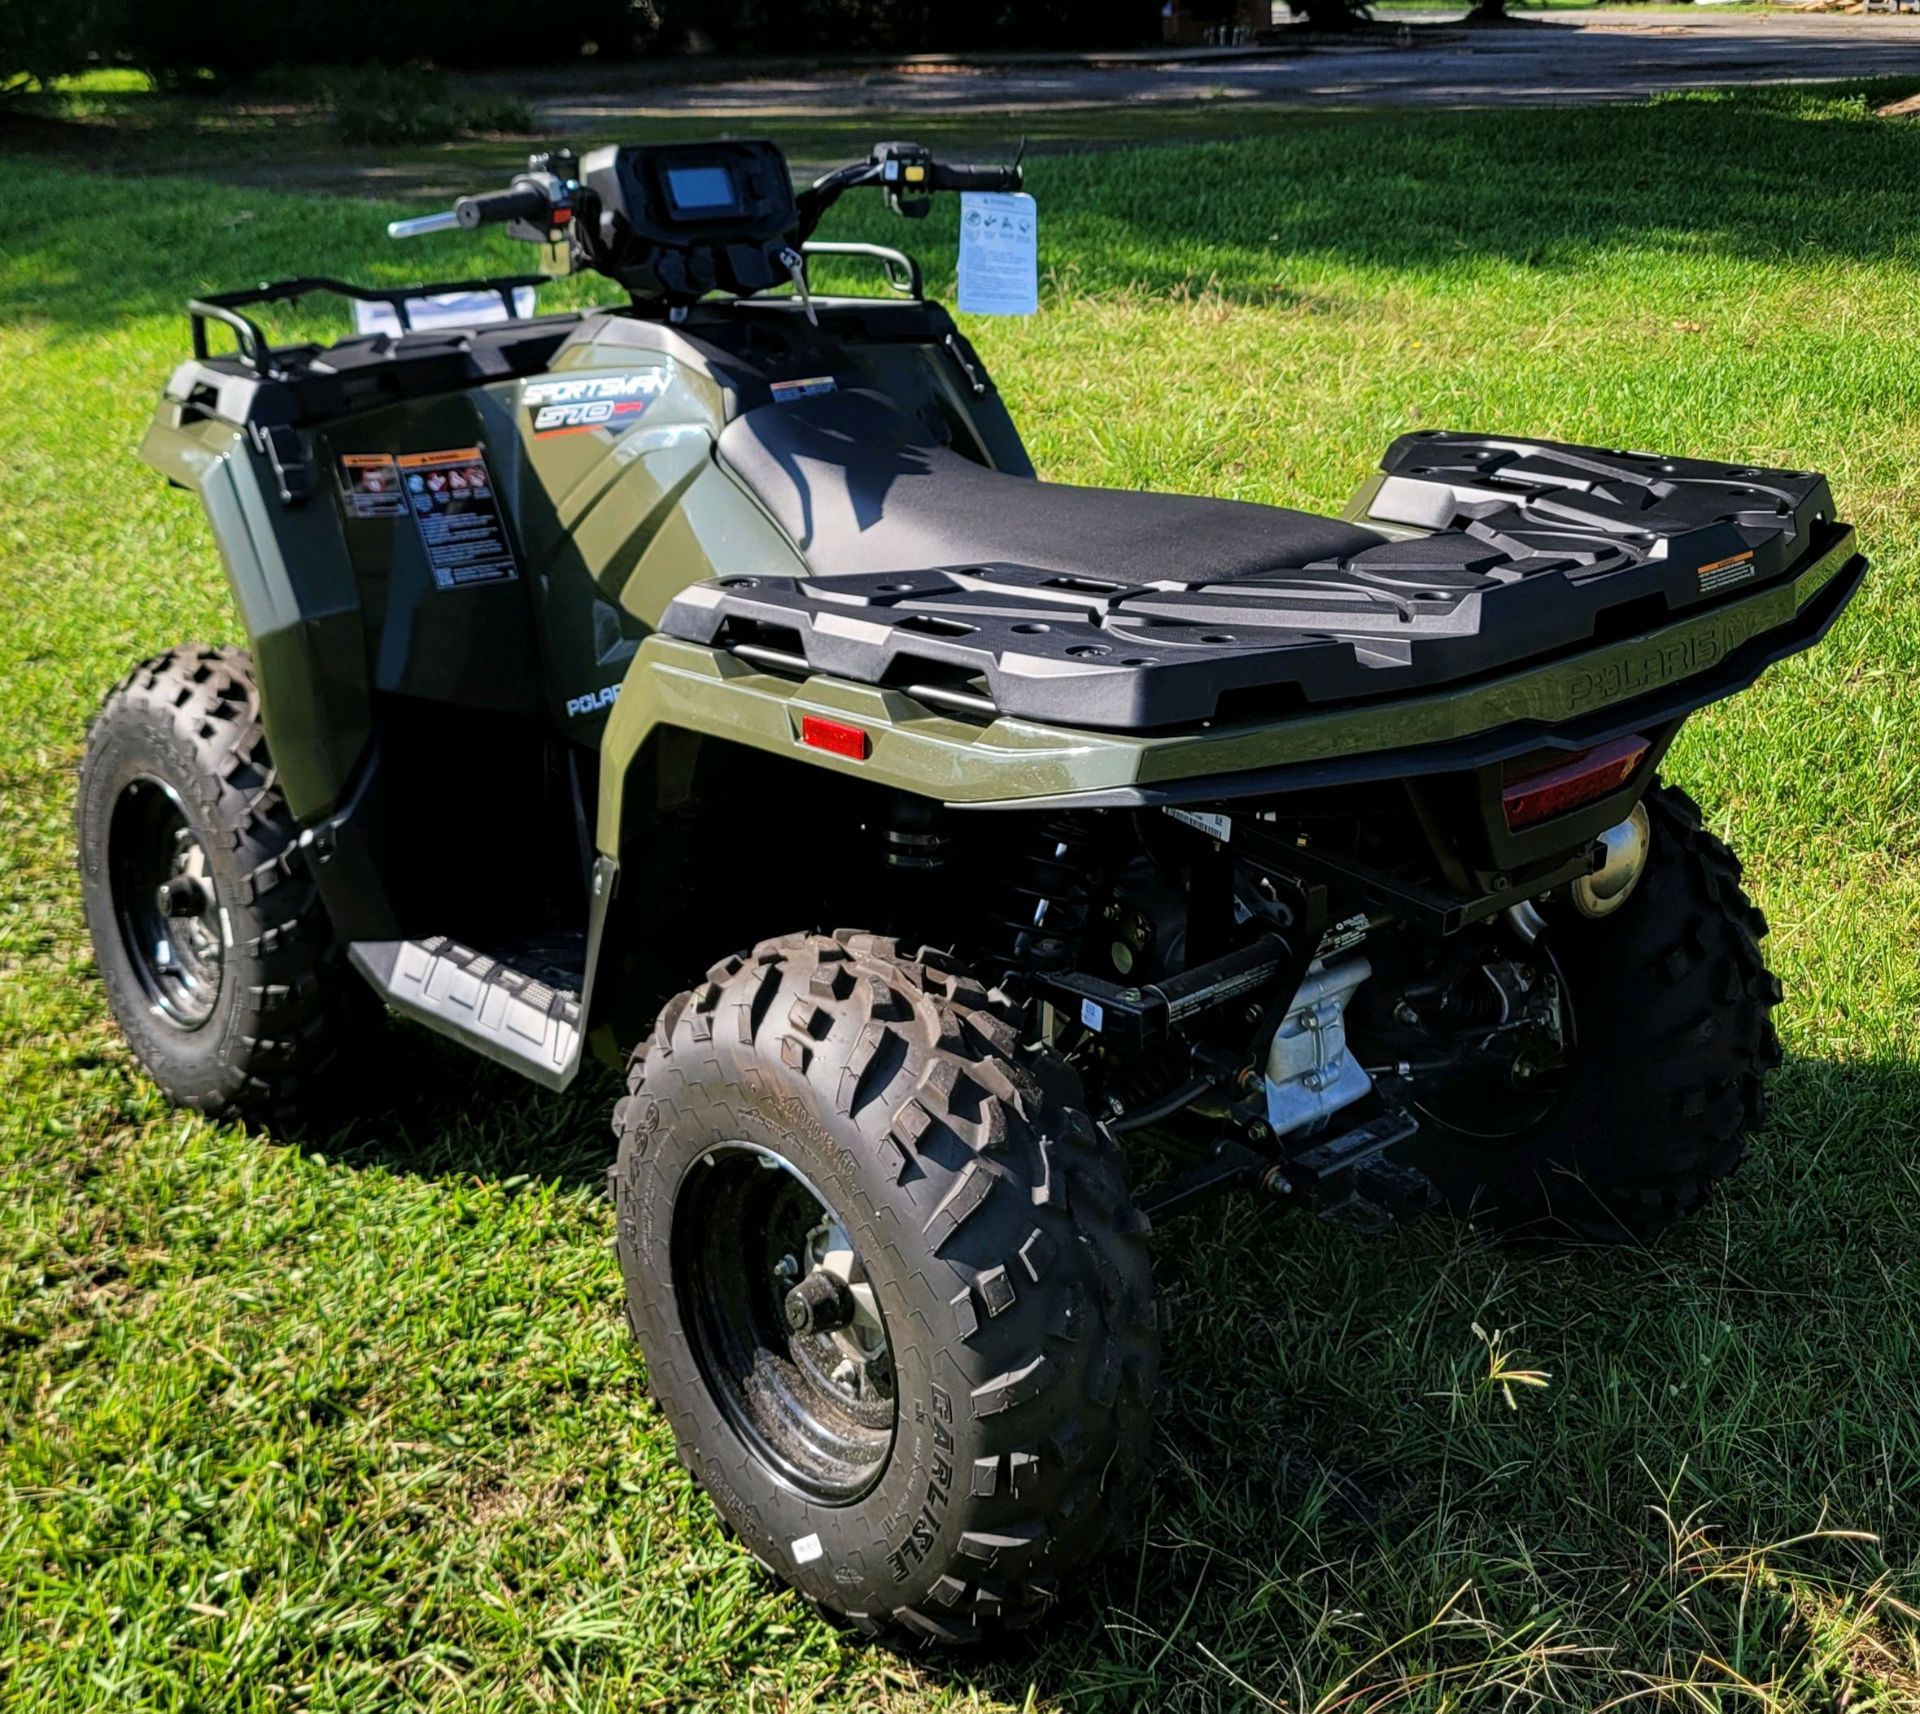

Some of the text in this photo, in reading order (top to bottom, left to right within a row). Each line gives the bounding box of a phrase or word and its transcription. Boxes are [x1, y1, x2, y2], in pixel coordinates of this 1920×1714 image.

[521, 368, 672, 405] SPORTSMAN
[534, 400, 615, 430] 570
[1567, 629, 1718, 711] POLARIS
[885, 1383, 953, 1583] CARLISLE
